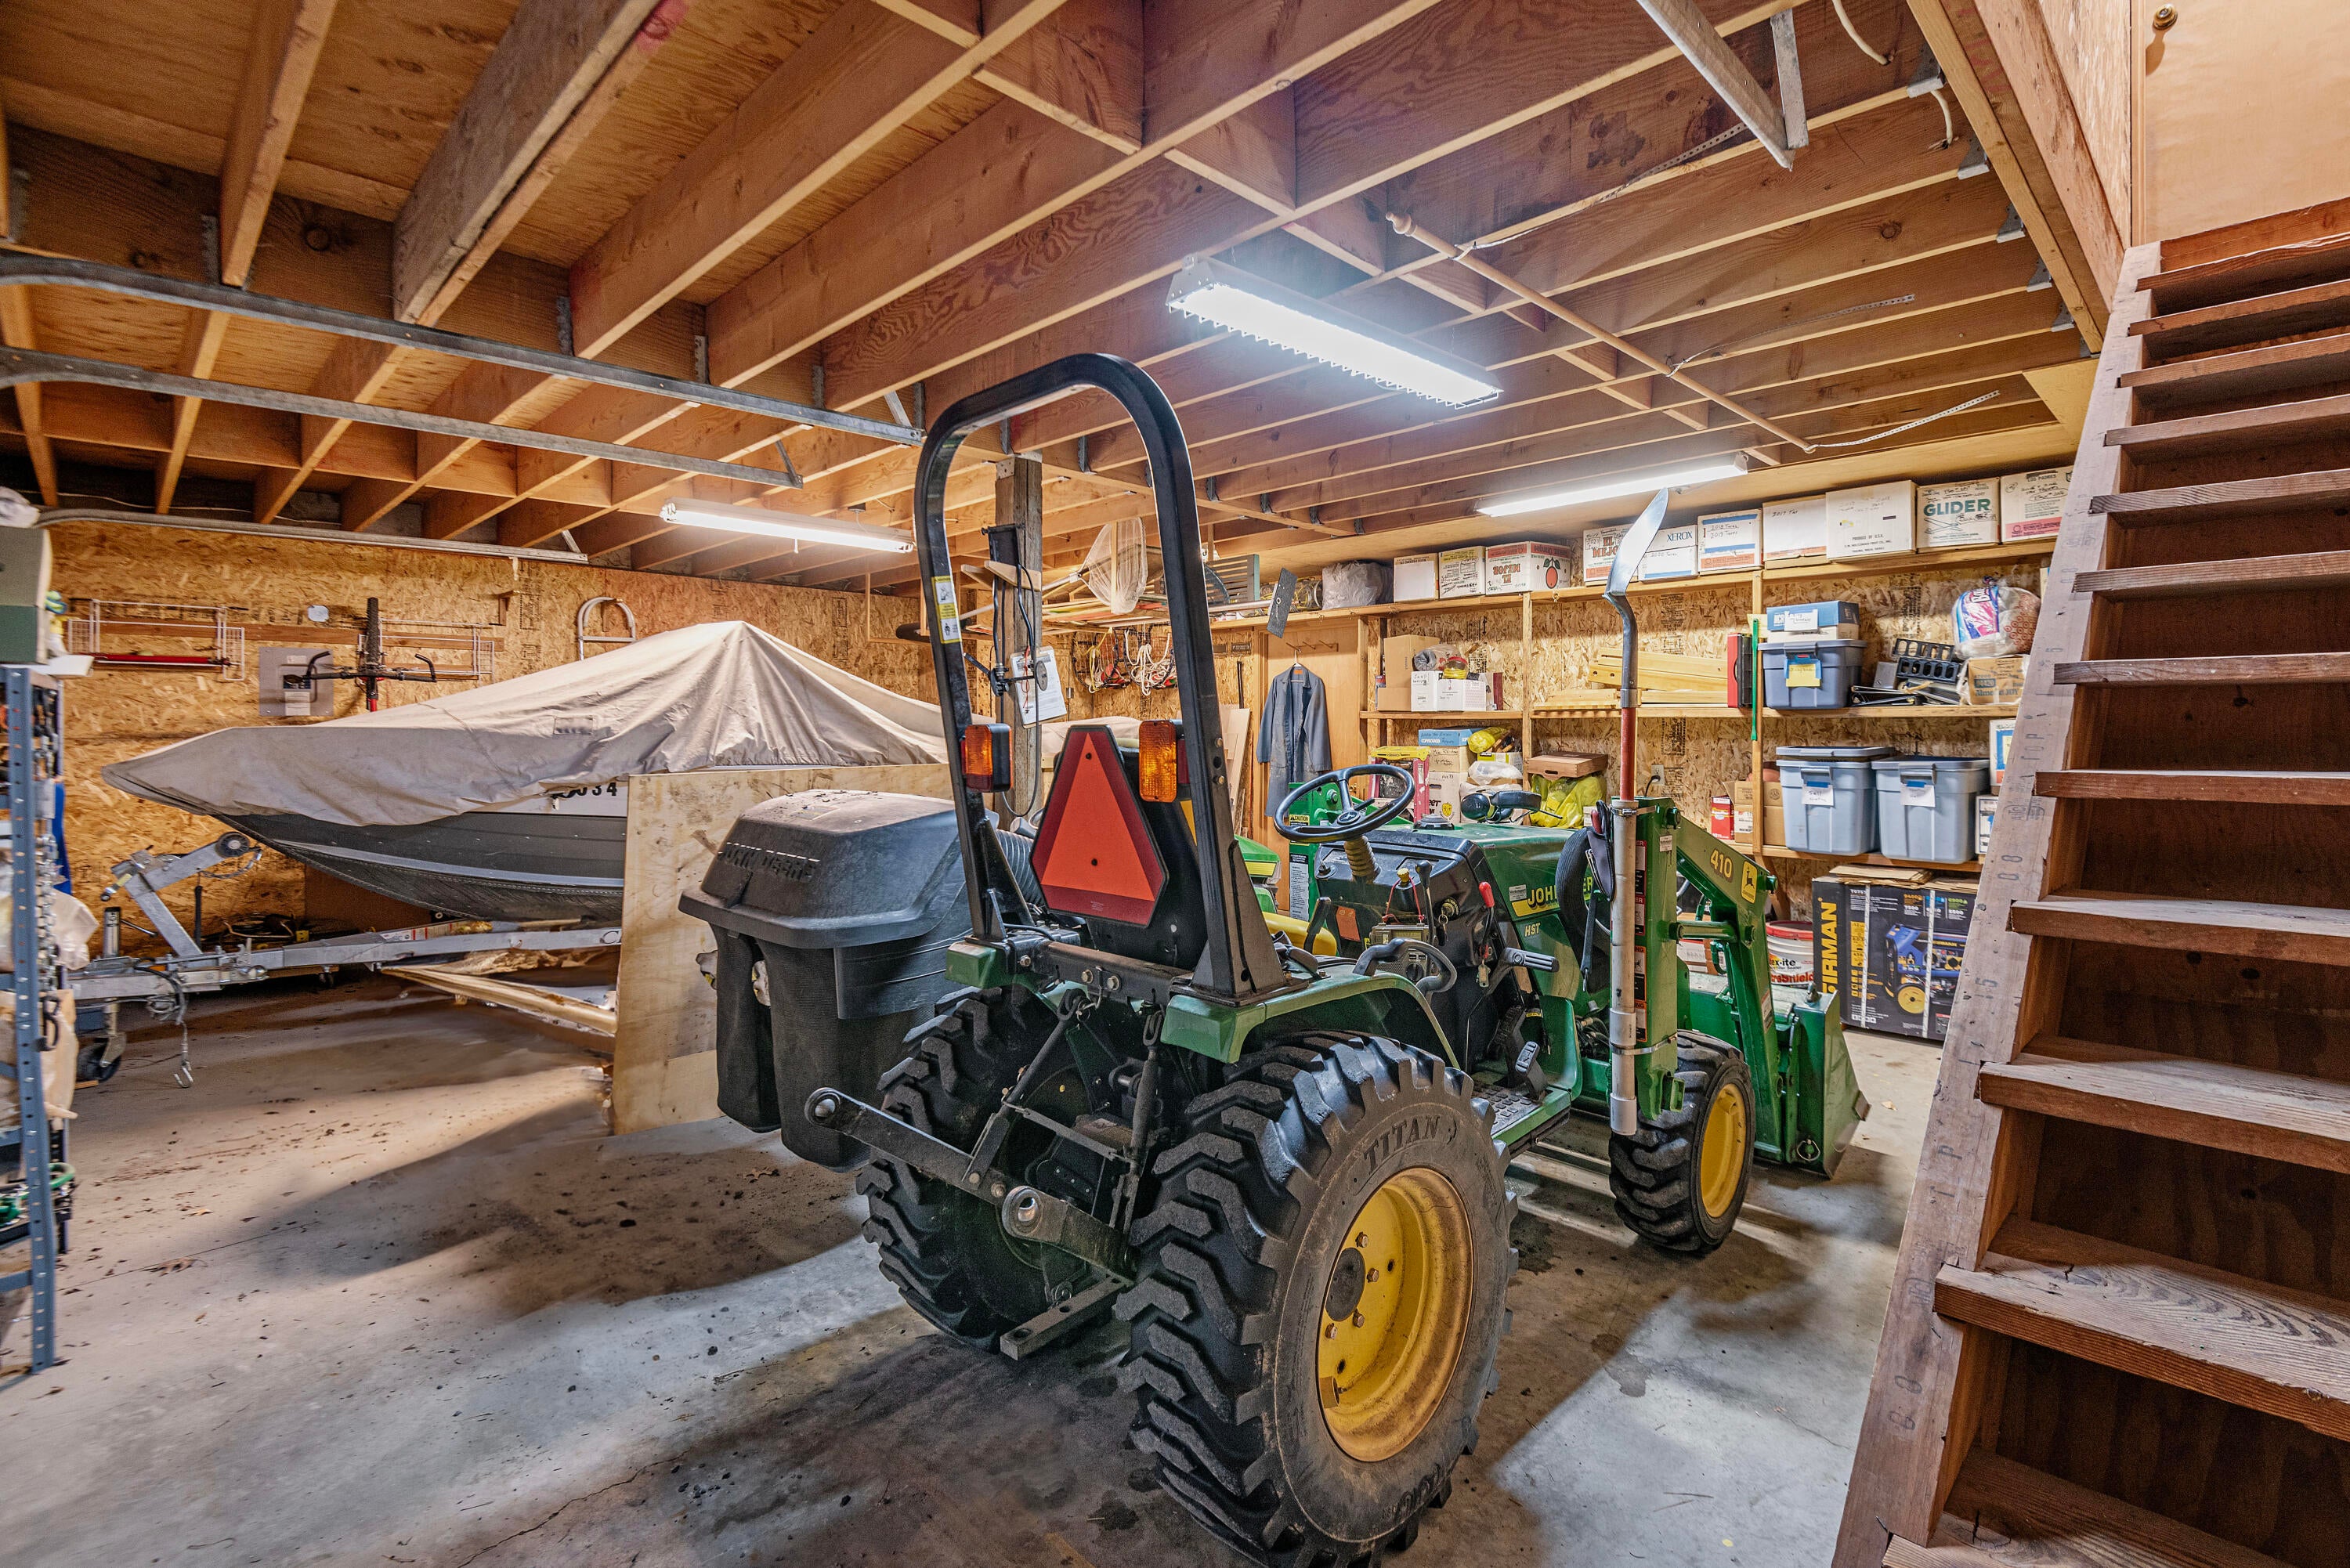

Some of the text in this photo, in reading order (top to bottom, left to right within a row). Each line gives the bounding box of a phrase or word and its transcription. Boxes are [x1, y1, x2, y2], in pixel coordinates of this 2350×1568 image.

[1923, 498, 1991, 517] GLIDER
[1603, 536, 1614, 547] EL
[1667, 531, 1693, 543] XEROX
[1593, 545, 1619, 558] MEJO
[1493, 563, 1521, 576] MEJOR
[1502, 573, 1512, 583] EL
[1710, 849, 1733, 879] 410
[1524, 922, 1541, 937] HST
[1363, 1115, 1441, 1176] TITAN
